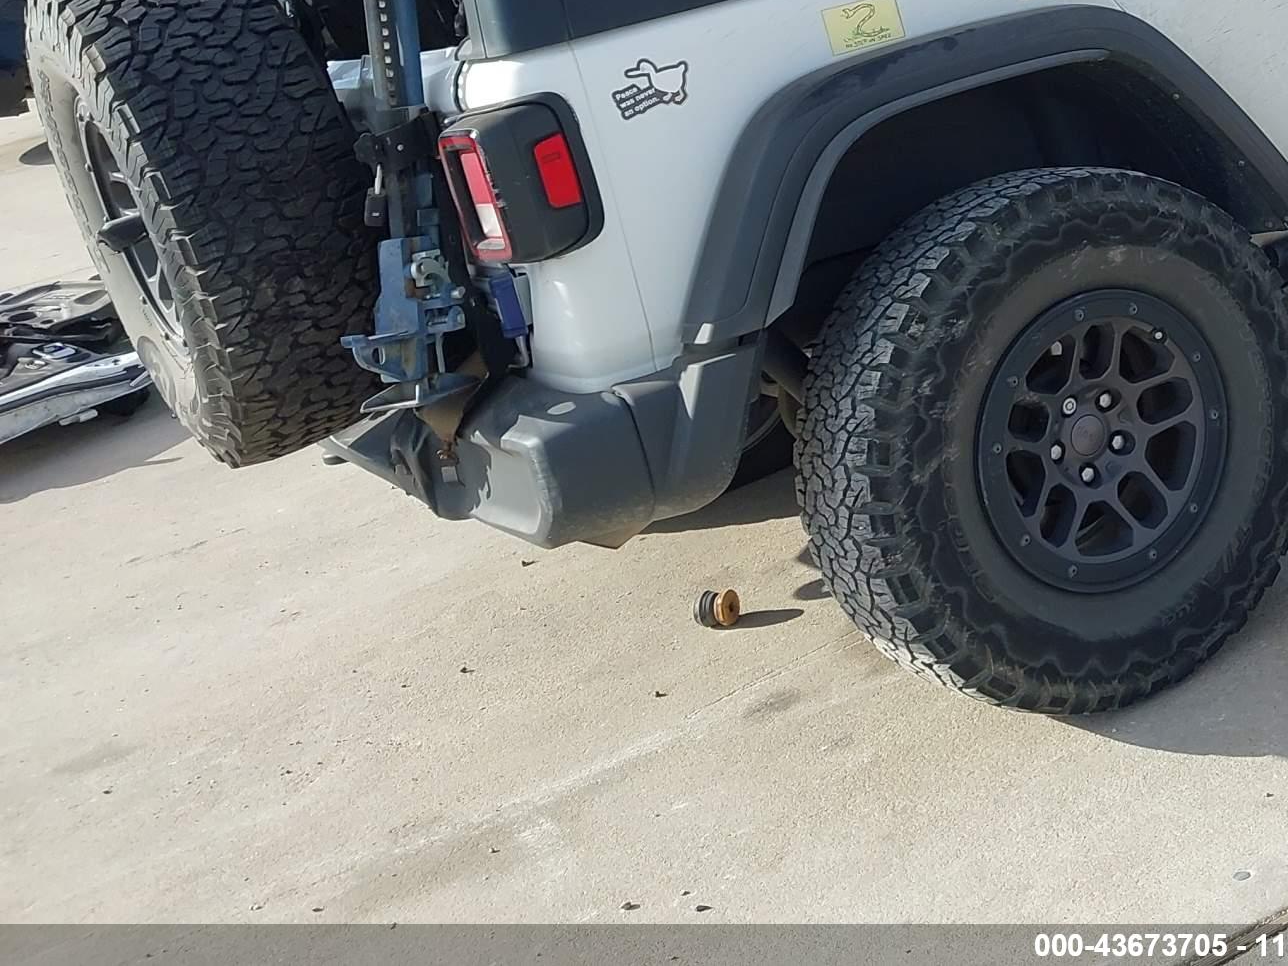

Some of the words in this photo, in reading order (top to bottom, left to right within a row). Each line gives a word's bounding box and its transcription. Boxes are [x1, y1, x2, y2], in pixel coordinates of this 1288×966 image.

[615, 87, 638, 101] Peace
[620, 98, 635, 108] was
[635, 87, 656, 101] never
[634, 96, 660, 111] option.
